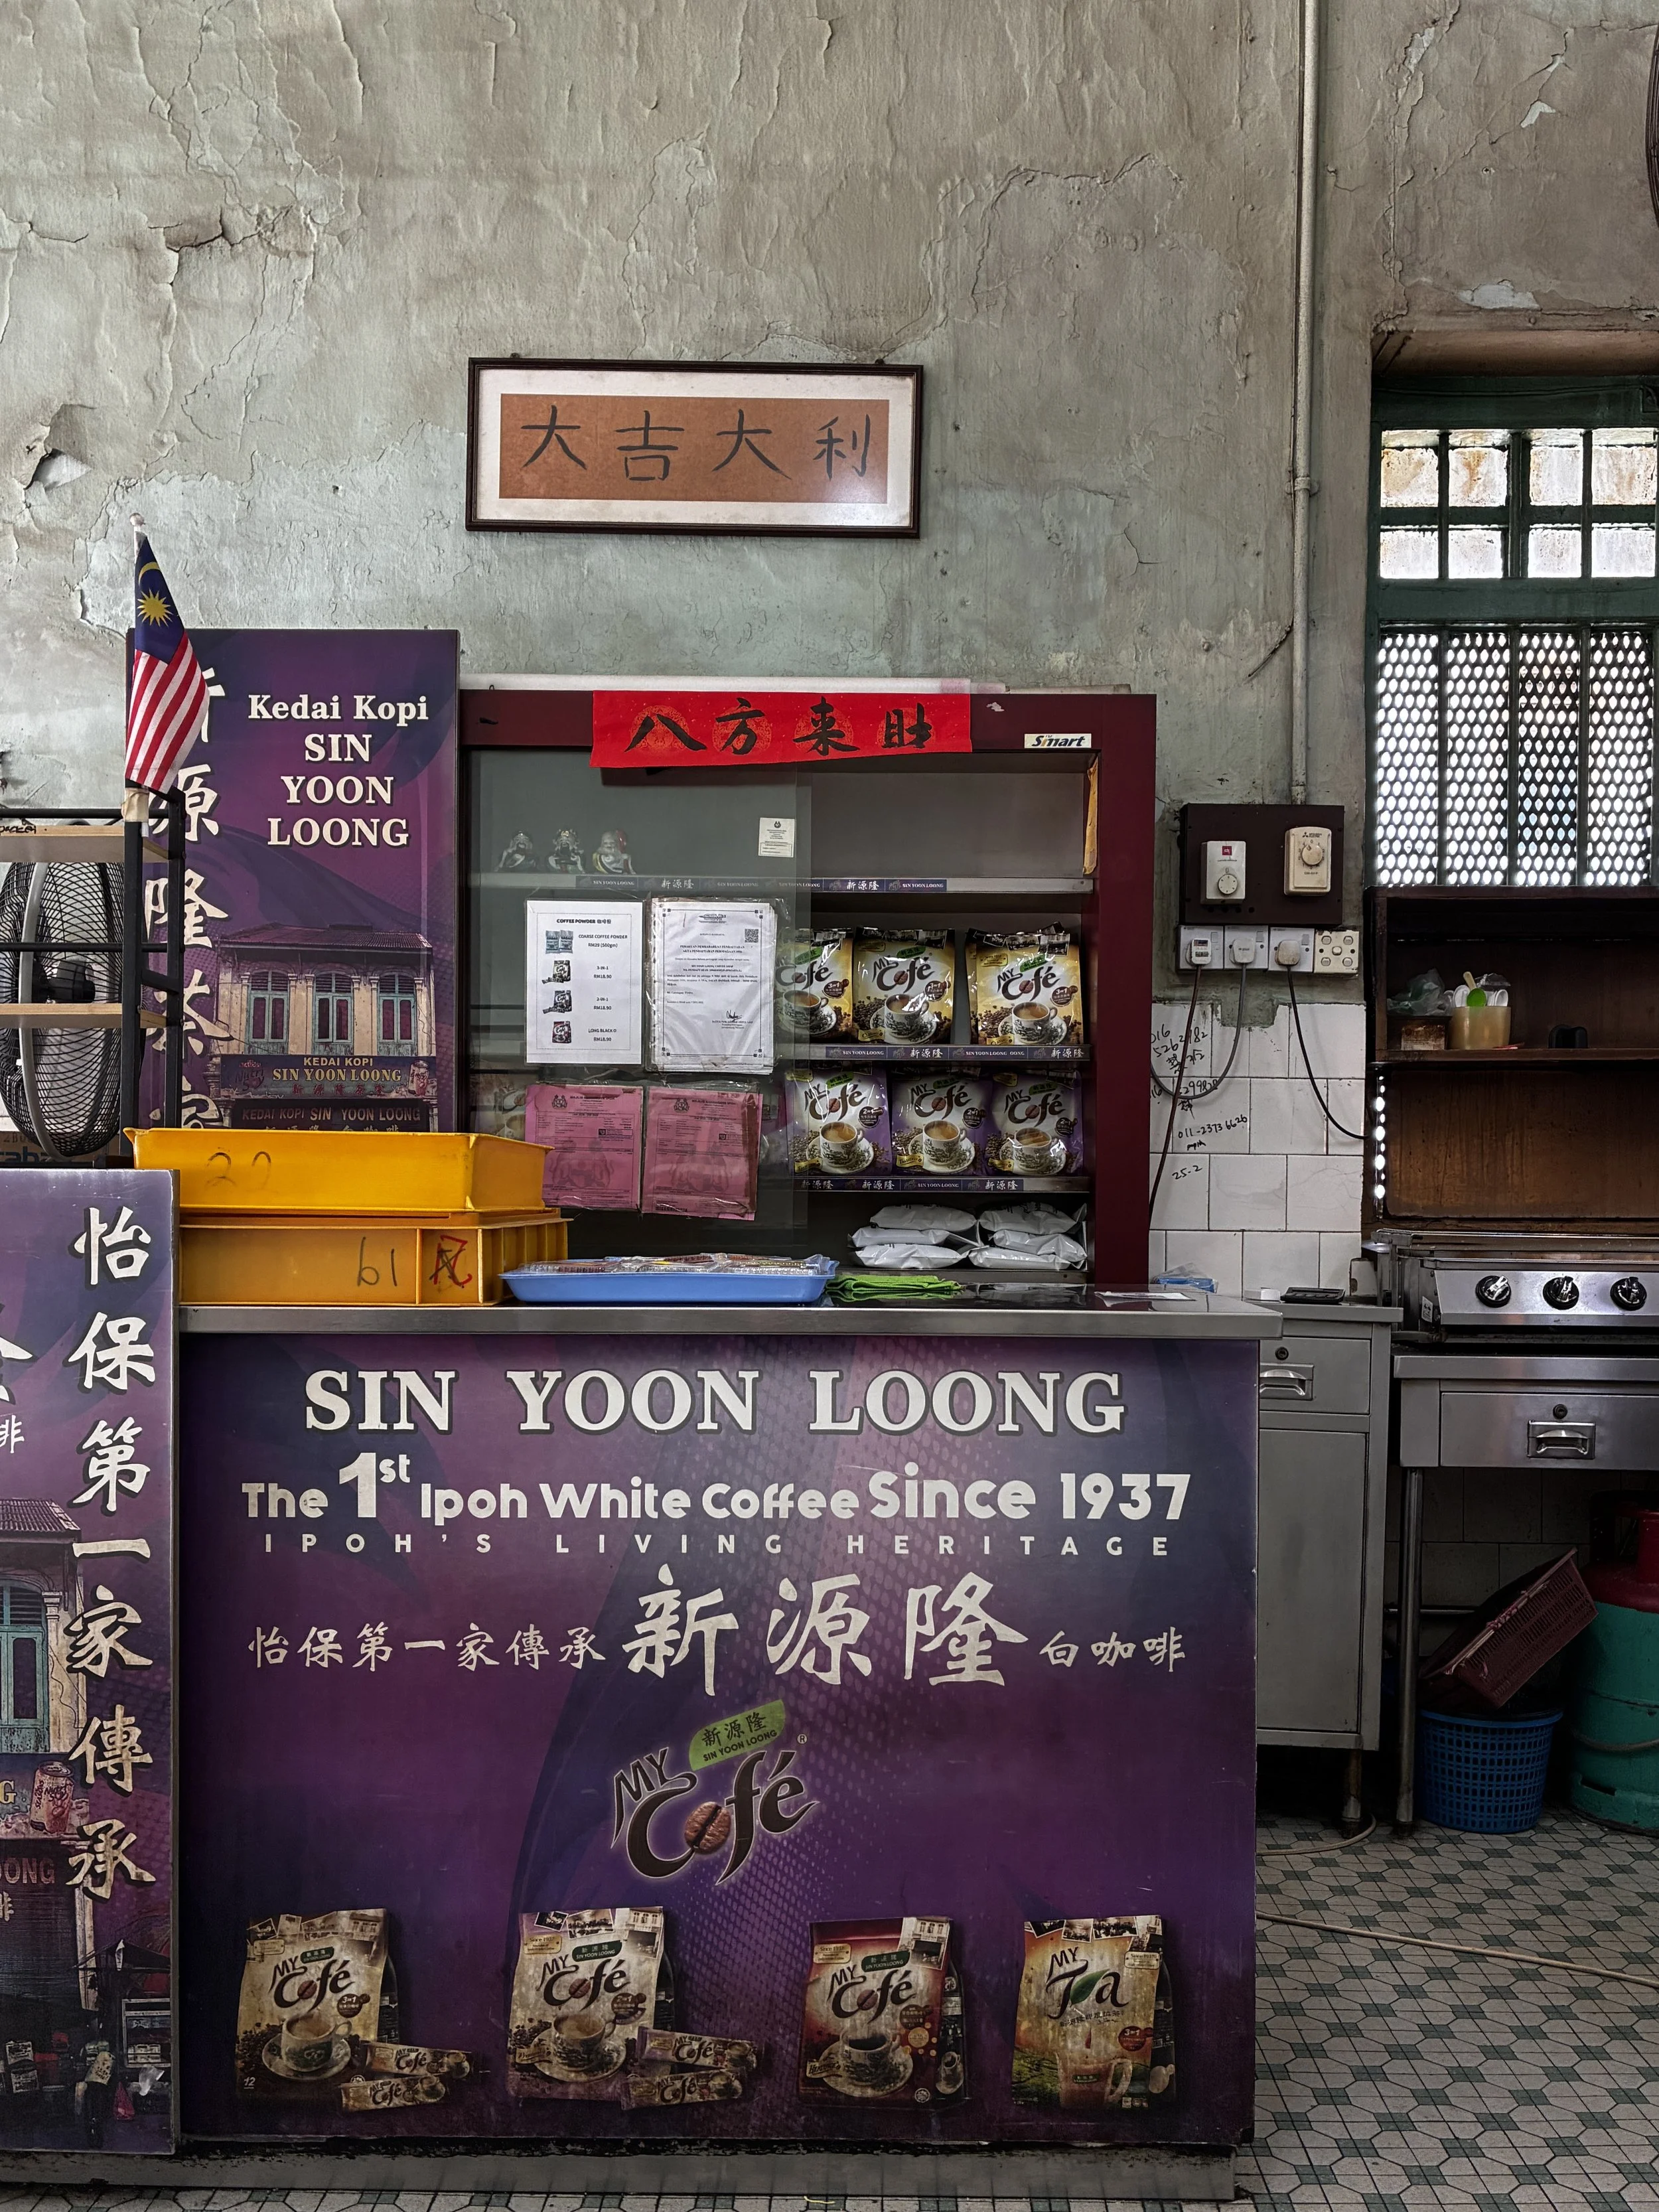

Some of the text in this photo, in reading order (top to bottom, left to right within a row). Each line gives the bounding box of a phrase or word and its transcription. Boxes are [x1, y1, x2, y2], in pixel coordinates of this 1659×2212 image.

[520, 405, 871, 481] 大吉大利
[248, 694, 429, 727] Kedai Kopi
[304, 733, 372, 761] SIN
[281, 776, 394, 804] YOON
[267, 818, 409, 846] LOONG
[661, 879, 694, 889] 新源隆
[846, 879, 879, 891] 新源隆
[303, 1057, 373, 1067] KEDAI KOPI
[910, 1048, 943, 1059] 新源隆
[1050, 1048, 1084, 1059] 新源隆
[273, 1069, 401, 1082] SIN YOON LOONG
[242, 1107, 420, 1121] KEDAI KOPI SIN YOON LOONG
[863, 1179, 895, 1191] 新源隆
[985, 1180, 1018, 1191] 新源隆
[1172, 1165, 1202, 1180] 25-2
[305, 1370, 1124, 1434] SIN YOON LOONG
[242, 1452, 1190, 1526] The 1st Ipoh White Coffee Since 1937
[66, 1206, 156, 1899] 怡保第一家傳承
[556, 1534, 781, 1554] LIVING
[847, 1534, 1168, 1556] HERITAGE
[248, 1563, 1185, 1696] 怡保第一家傳承 新源隆 白咖啡
[701, 1712, 766, 1747] 新源隆
[703, 1730, 777, 1761] SIN YOON LOONG
[611, 1747, 669, 1849] MY
[269, 1956, 299, 1994] MY
[536, 1954, 569, 1991] MY
[1046, 1947, 1078, 1983] MY
[827, 1964, 856, 2002] MY
[244, 2077, 256, 2086] 12
